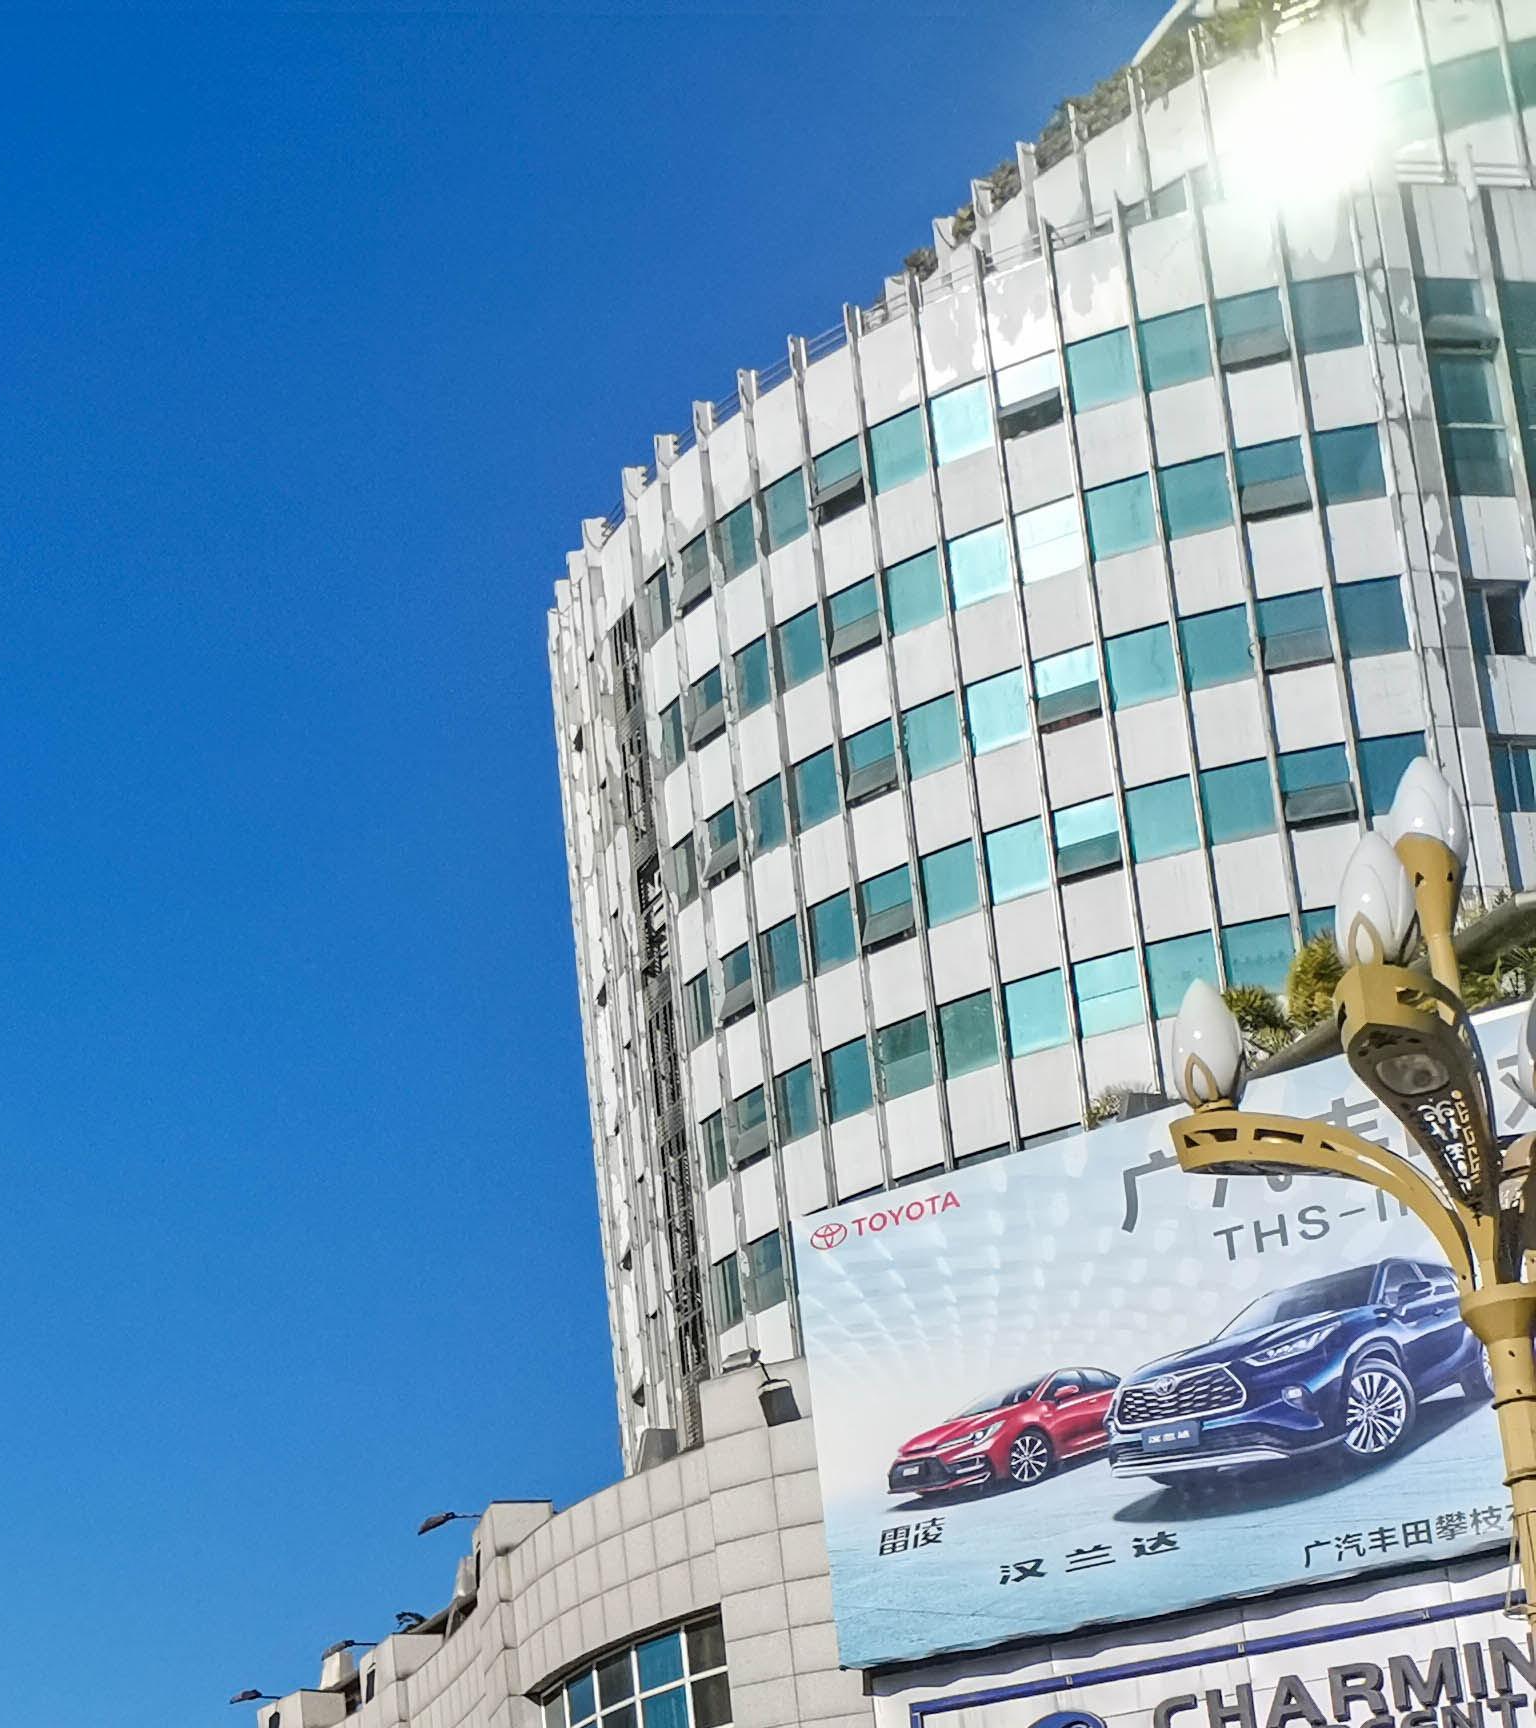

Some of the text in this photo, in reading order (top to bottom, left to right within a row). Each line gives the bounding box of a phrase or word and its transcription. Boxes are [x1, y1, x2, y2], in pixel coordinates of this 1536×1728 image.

[851, 1191, 961, 1236] TOYOTA
[879, 1516, 945, 1556] 雷凌
[999, 1530, 1180, 1585] 汉兰达
